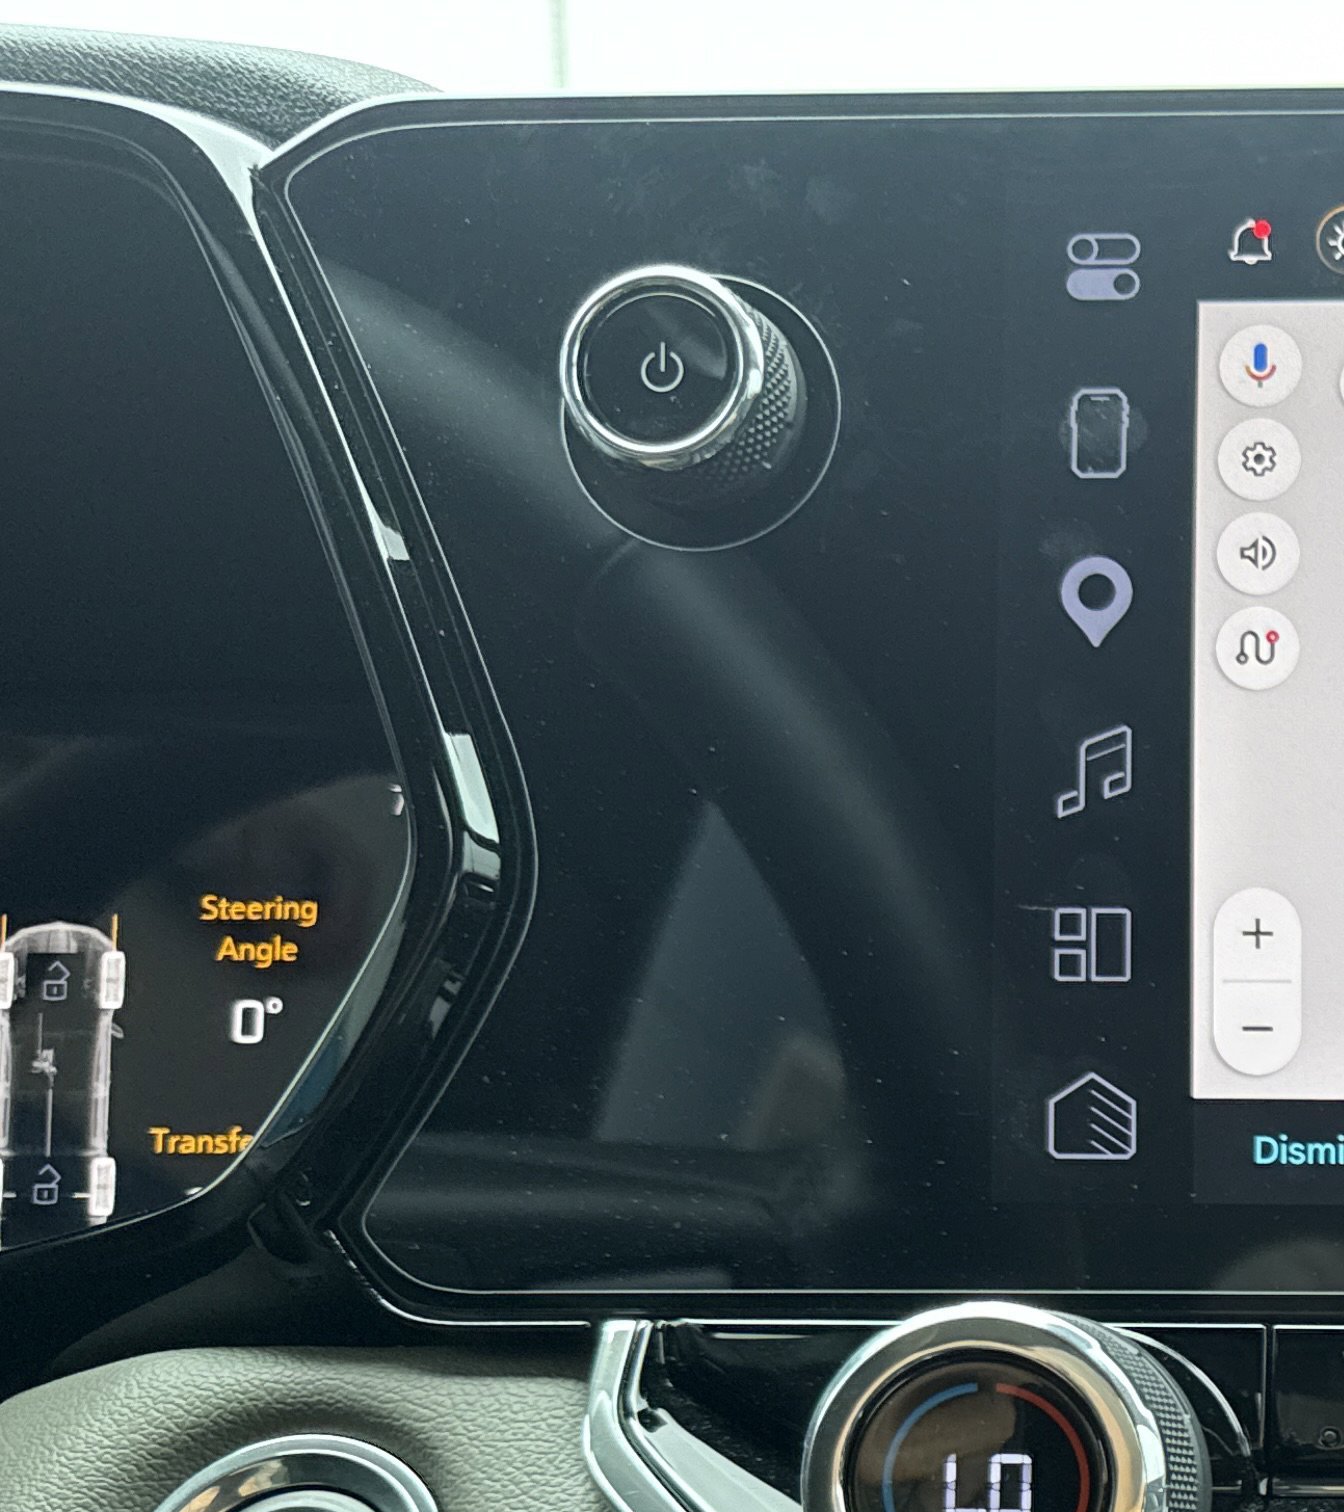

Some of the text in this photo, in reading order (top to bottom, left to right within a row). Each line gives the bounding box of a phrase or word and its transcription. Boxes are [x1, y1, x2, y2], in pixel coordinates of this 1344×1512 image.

[199, 894, 319, 929] Steering
[216, 936, 299, 969] Angle
[231, 996, 283, 1045] 0°
